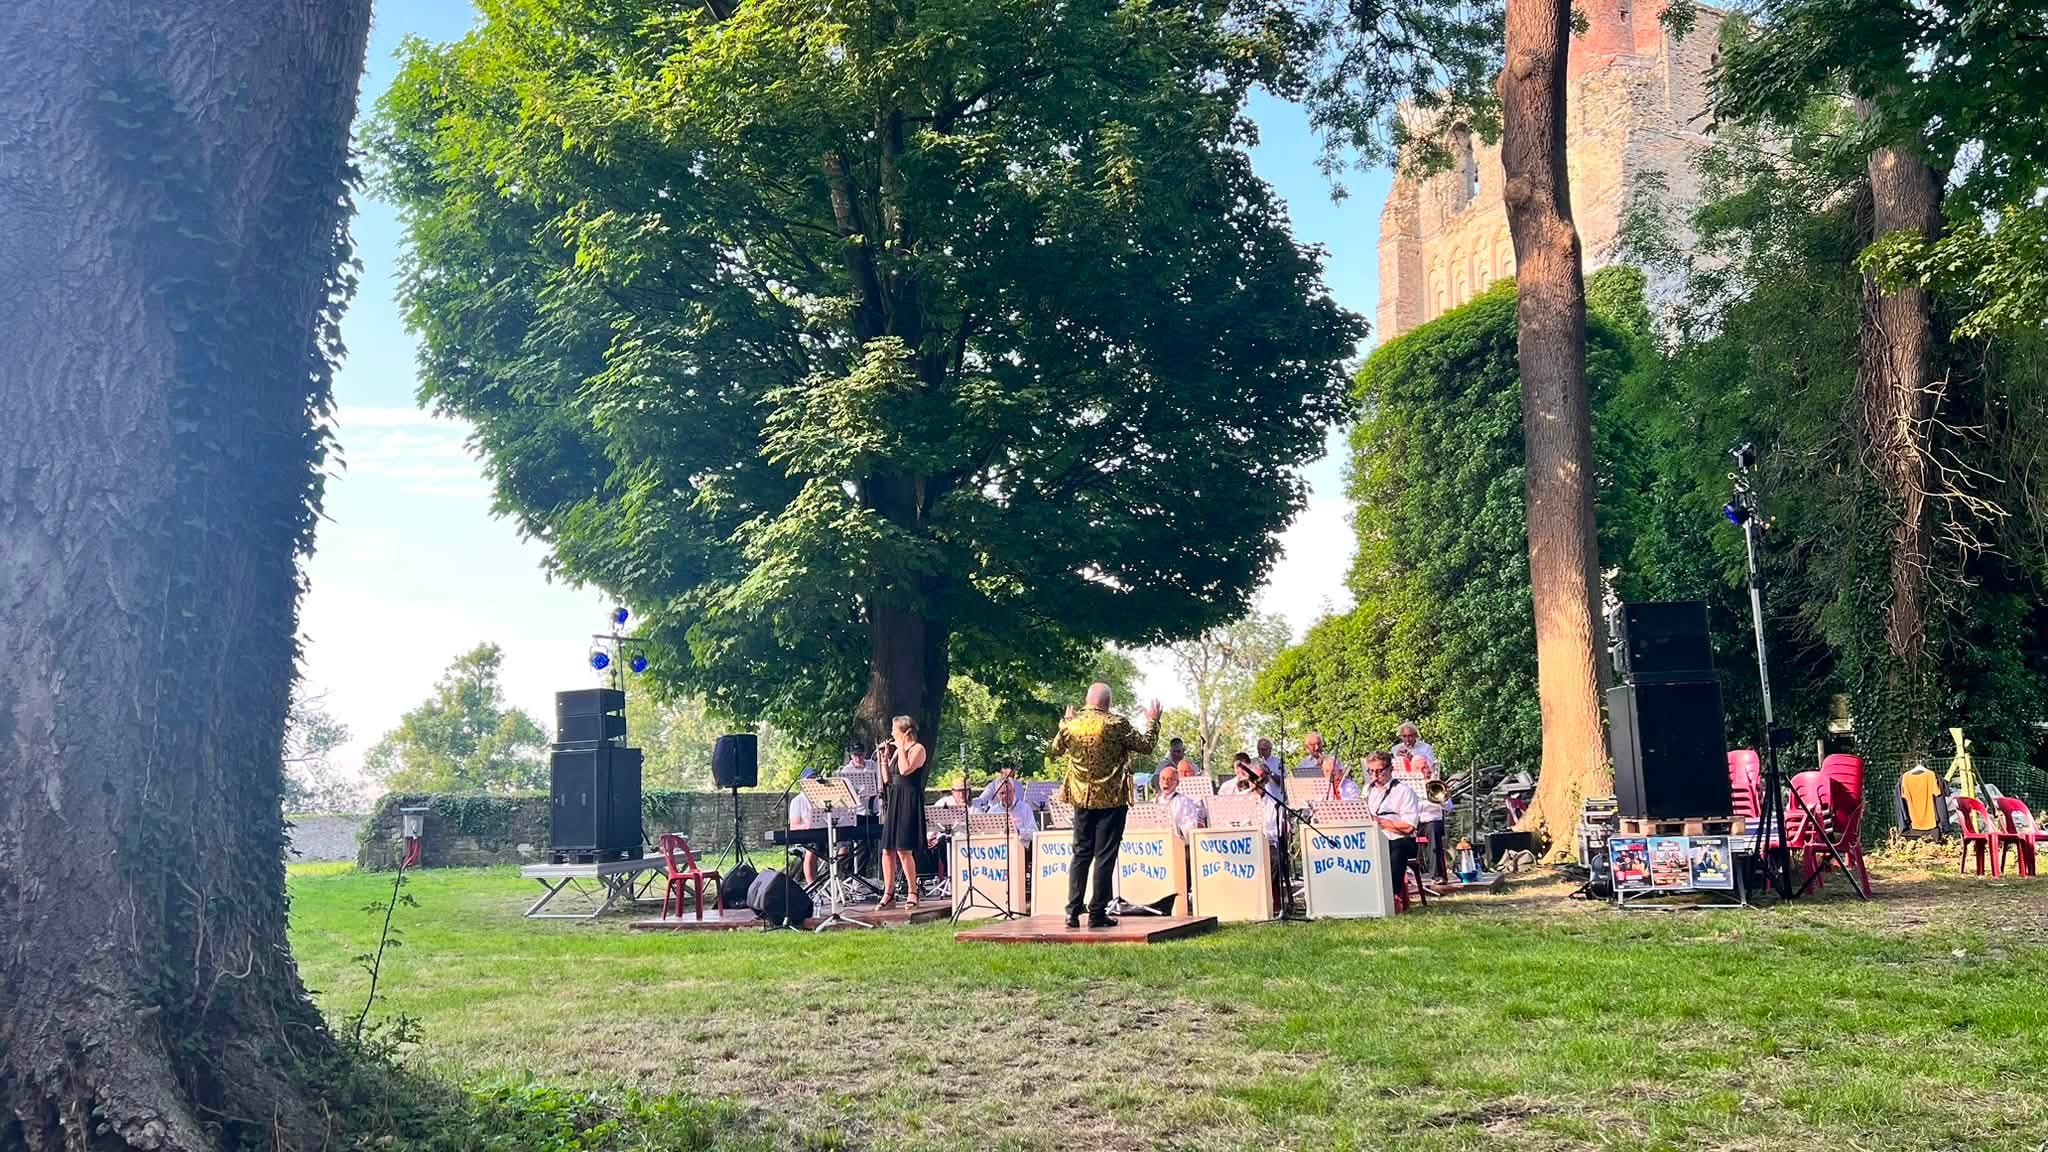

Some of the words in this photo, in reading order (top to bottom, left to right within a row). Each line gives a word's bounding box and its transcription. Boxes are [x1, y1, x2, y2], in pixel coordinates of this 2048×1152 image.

[1120, 841, 1144, 856] OPUS
[1145, 840, 1164, 857] ONE
[1201, 839, 1229, 854] OPUS
[1231, 837, 1252, 855] ONE
[1344, 831, 1366, 850] ONE
[988, 843, 1009, 860] ONE
[1042, 843, 1066, 856] OPUS
[1042, 863, 1059, 878] BIG
[1122, 863, 1138, 878] BIG
[1140, 863, 1167, 881] BAND
[1202, 861, 1221, 877] BIG
[1224, 861, 1255, 879] BAND
[1314, 857, 1335, 874] BIG
[1337, 856, 1371, 874] BAND
[962, 866, 980, 882] BG
